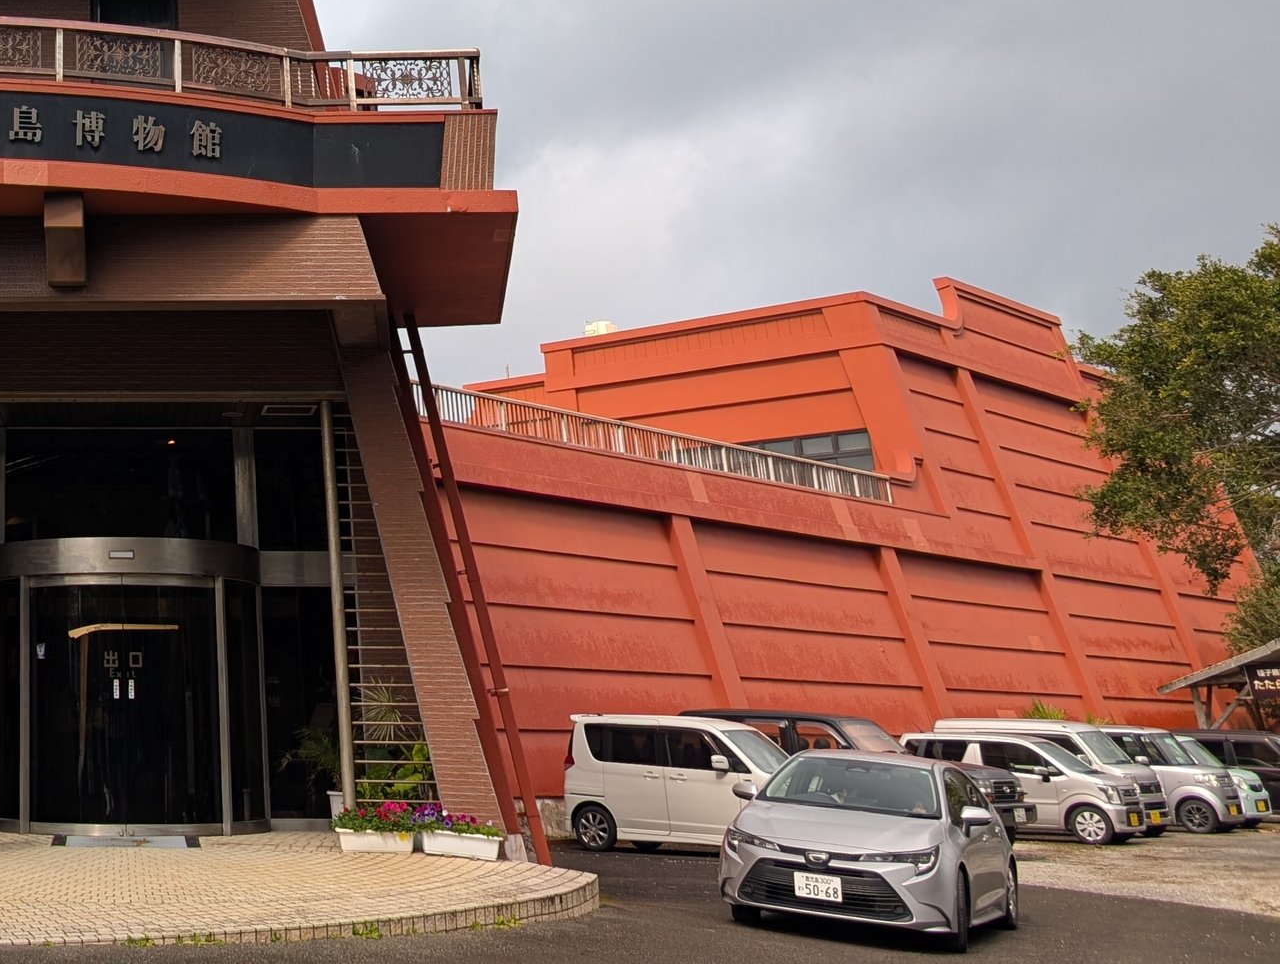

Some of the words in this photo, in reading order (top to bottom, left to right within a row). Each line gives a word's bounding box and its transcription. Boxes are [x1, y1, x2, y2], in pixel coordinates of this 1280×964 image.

[104, 650, 142, 667] 出口
[109, 667, 137, 678] Exit
[1256, 668, 1280, 677] 種子島
[805, 883, 839, 899] 50-68
